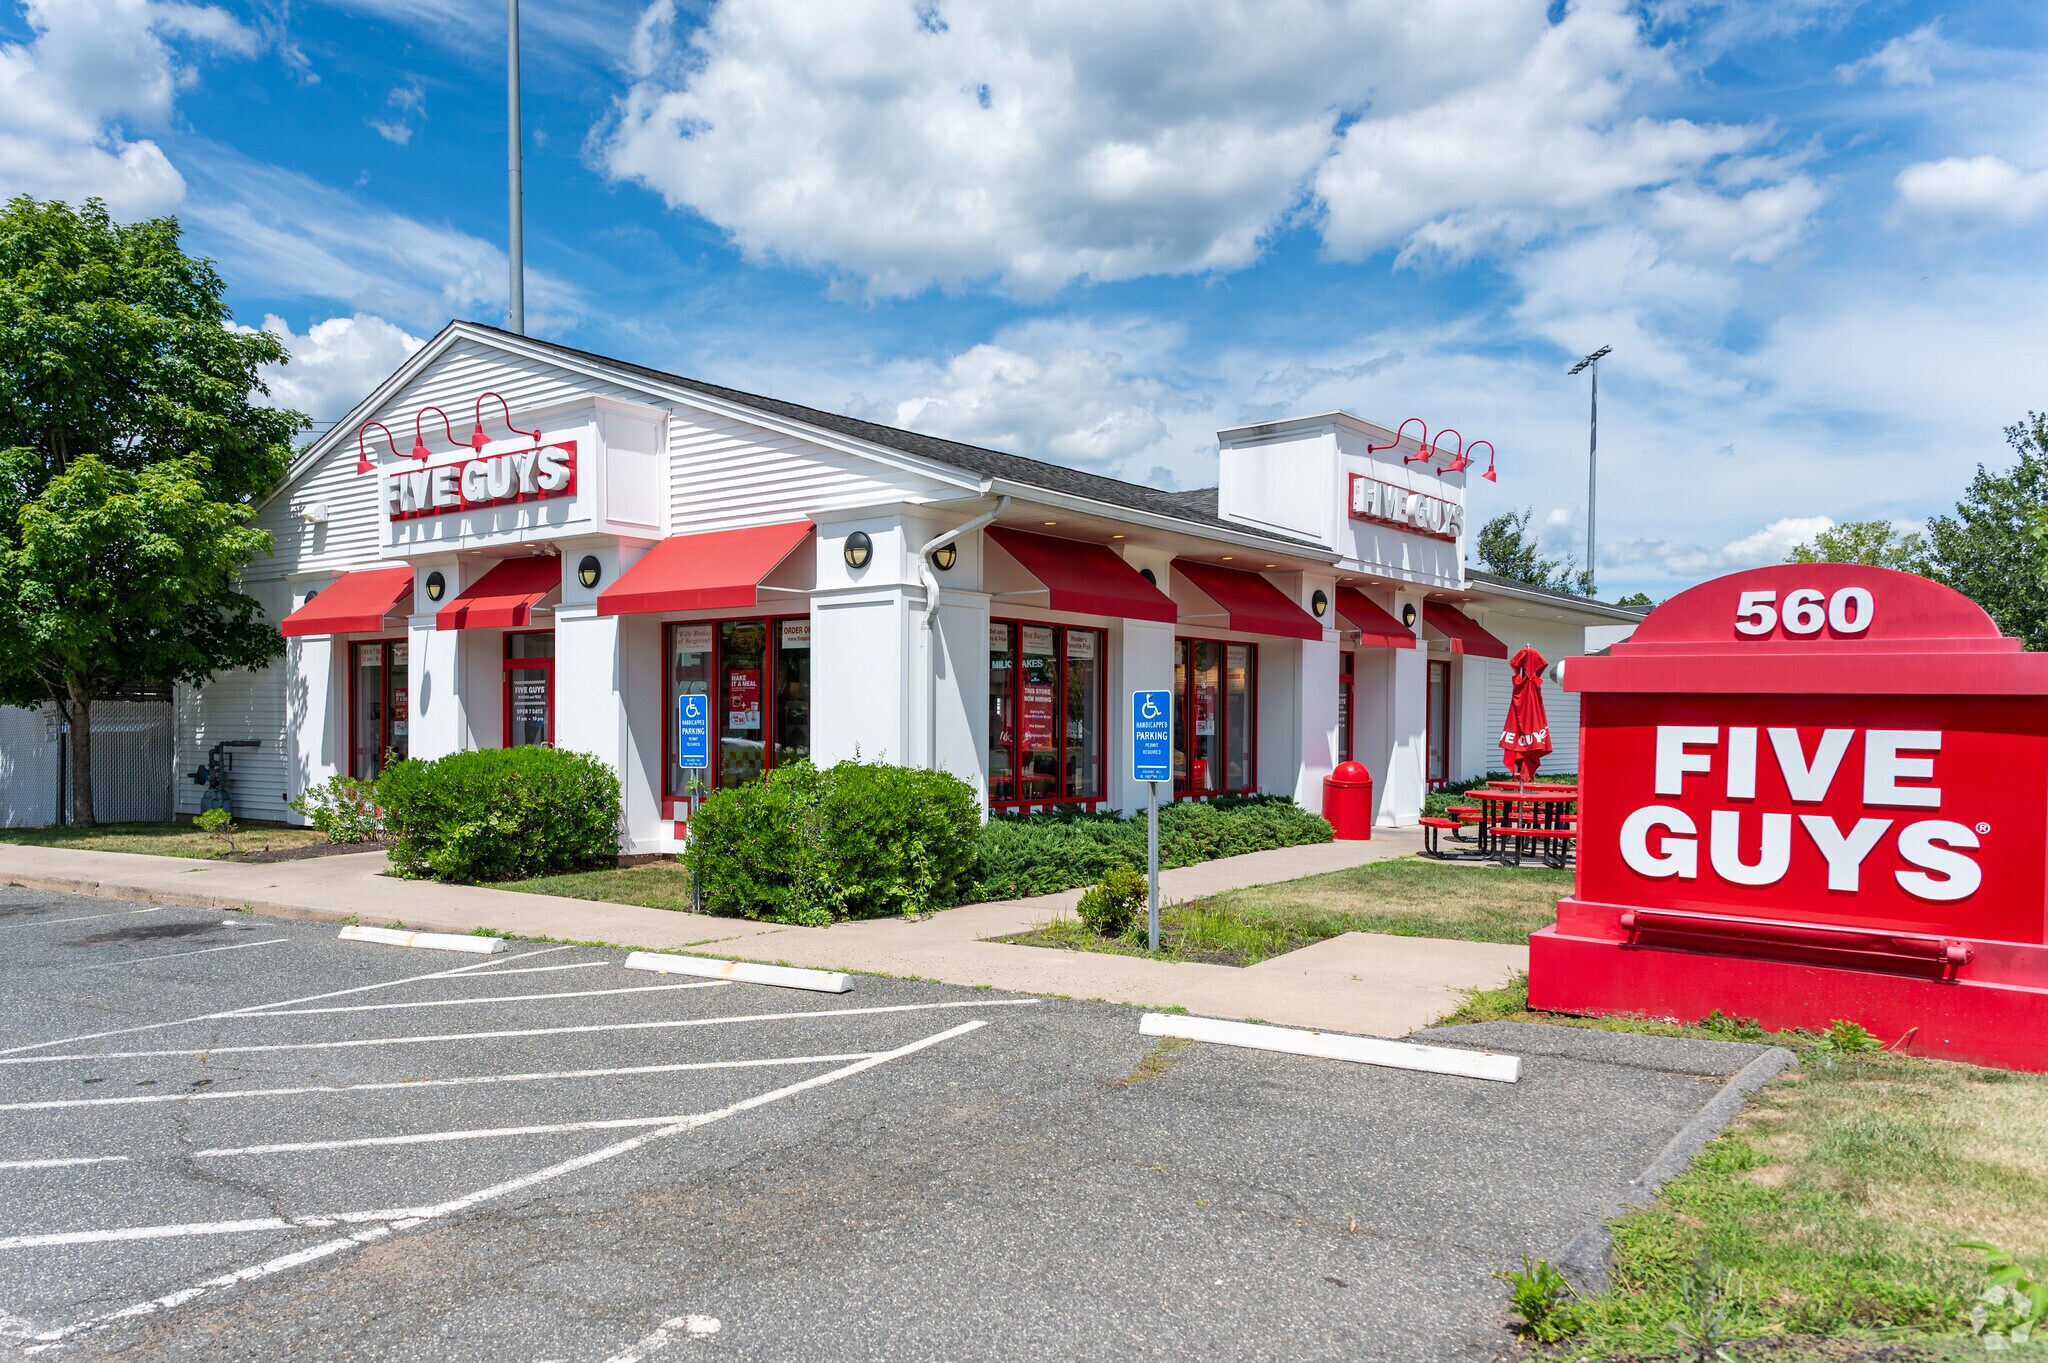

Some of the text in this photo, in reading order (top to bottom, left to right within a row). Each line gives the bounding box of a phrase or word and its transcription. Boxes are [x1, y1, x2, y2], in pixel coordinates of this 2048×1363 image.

[382, 446, 570, 514] FIVE GUYS
[1353, 477, 1464, 538] FIVE GUYS
[1735, 586, 1875, 636] 560
[682, 727, 705, 735] PARKING
[1136, 731, 1168, 741] PARKING
[1654, 725, 1942, 808] FIVE
